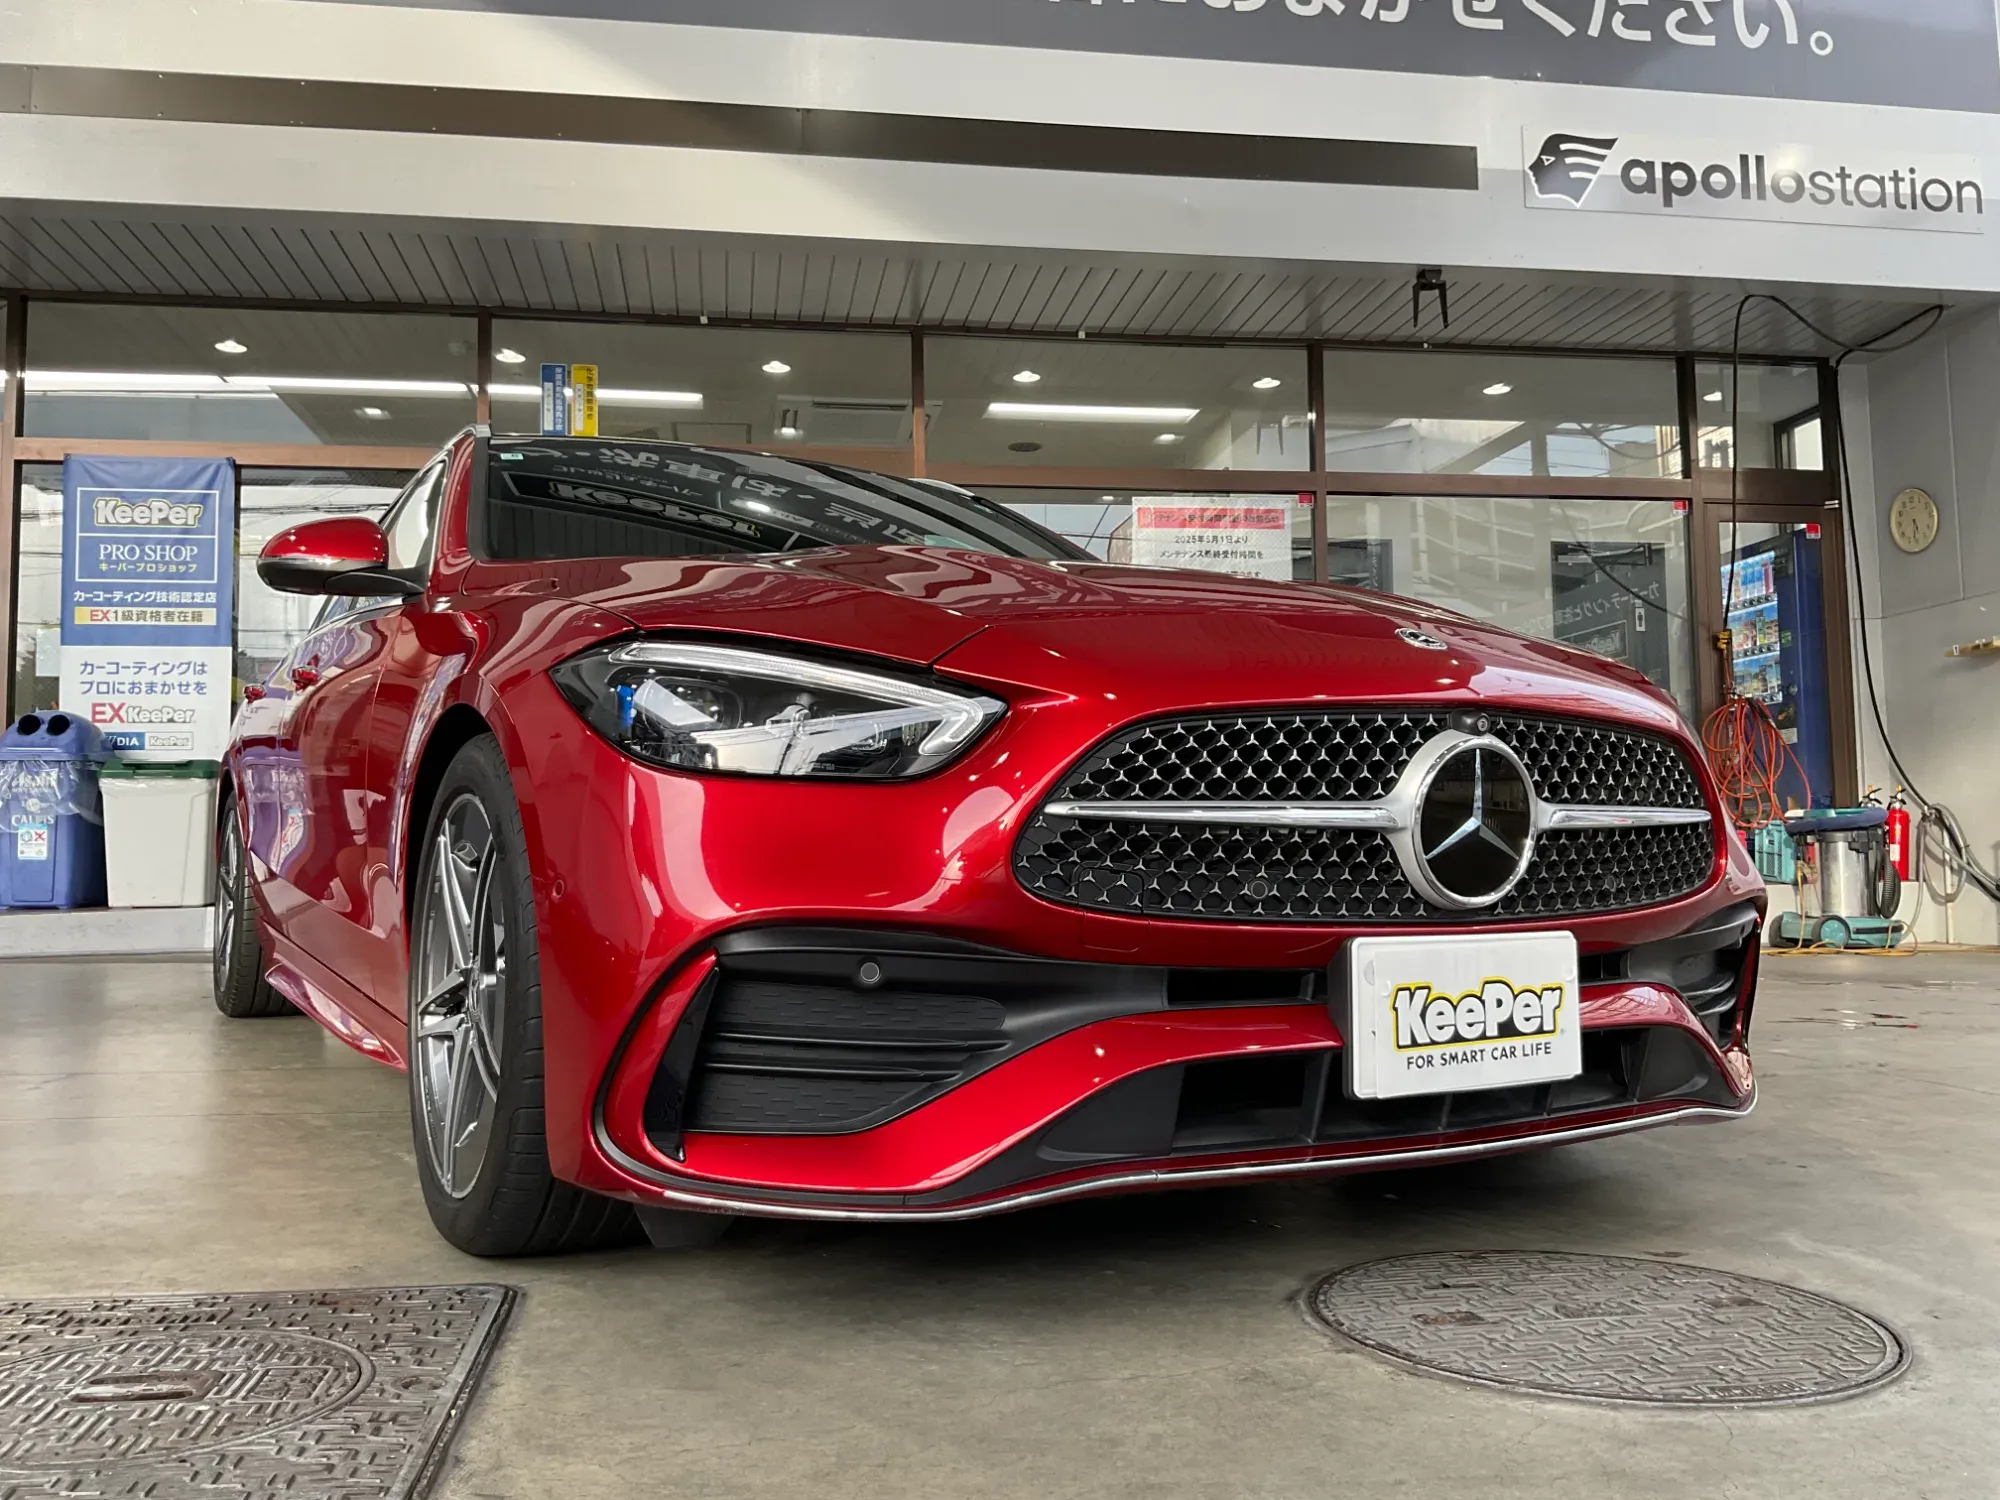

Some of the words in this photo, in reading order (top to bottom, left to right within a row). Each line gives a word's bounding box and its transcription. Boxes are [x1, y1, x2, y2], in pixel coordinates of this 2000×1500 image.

[1620, 154, 1984, 214] apollostation
[95, 498, 202, 527] KeePer
[99, 544, 139, 560] PRO
[144, 545, 198, 561] SHOP
[99, 562, 198, 573] キーパープロショップ
[74, 590, 217, 604] カーコーティング技術認定店
[80, 661, 207, 676] カーコーティングは
[80, 680, 207, 695] プロにおまかせを
[1393, 979, 1564, 1049] KeePer
[1407, 1055, 1435, 1070] FOR
[1440, 1049, 1486, 1066] SMART
[1491, 1046, 1517, 1061] CAR
[1522, 1042, 1552, 1057] LIFE
